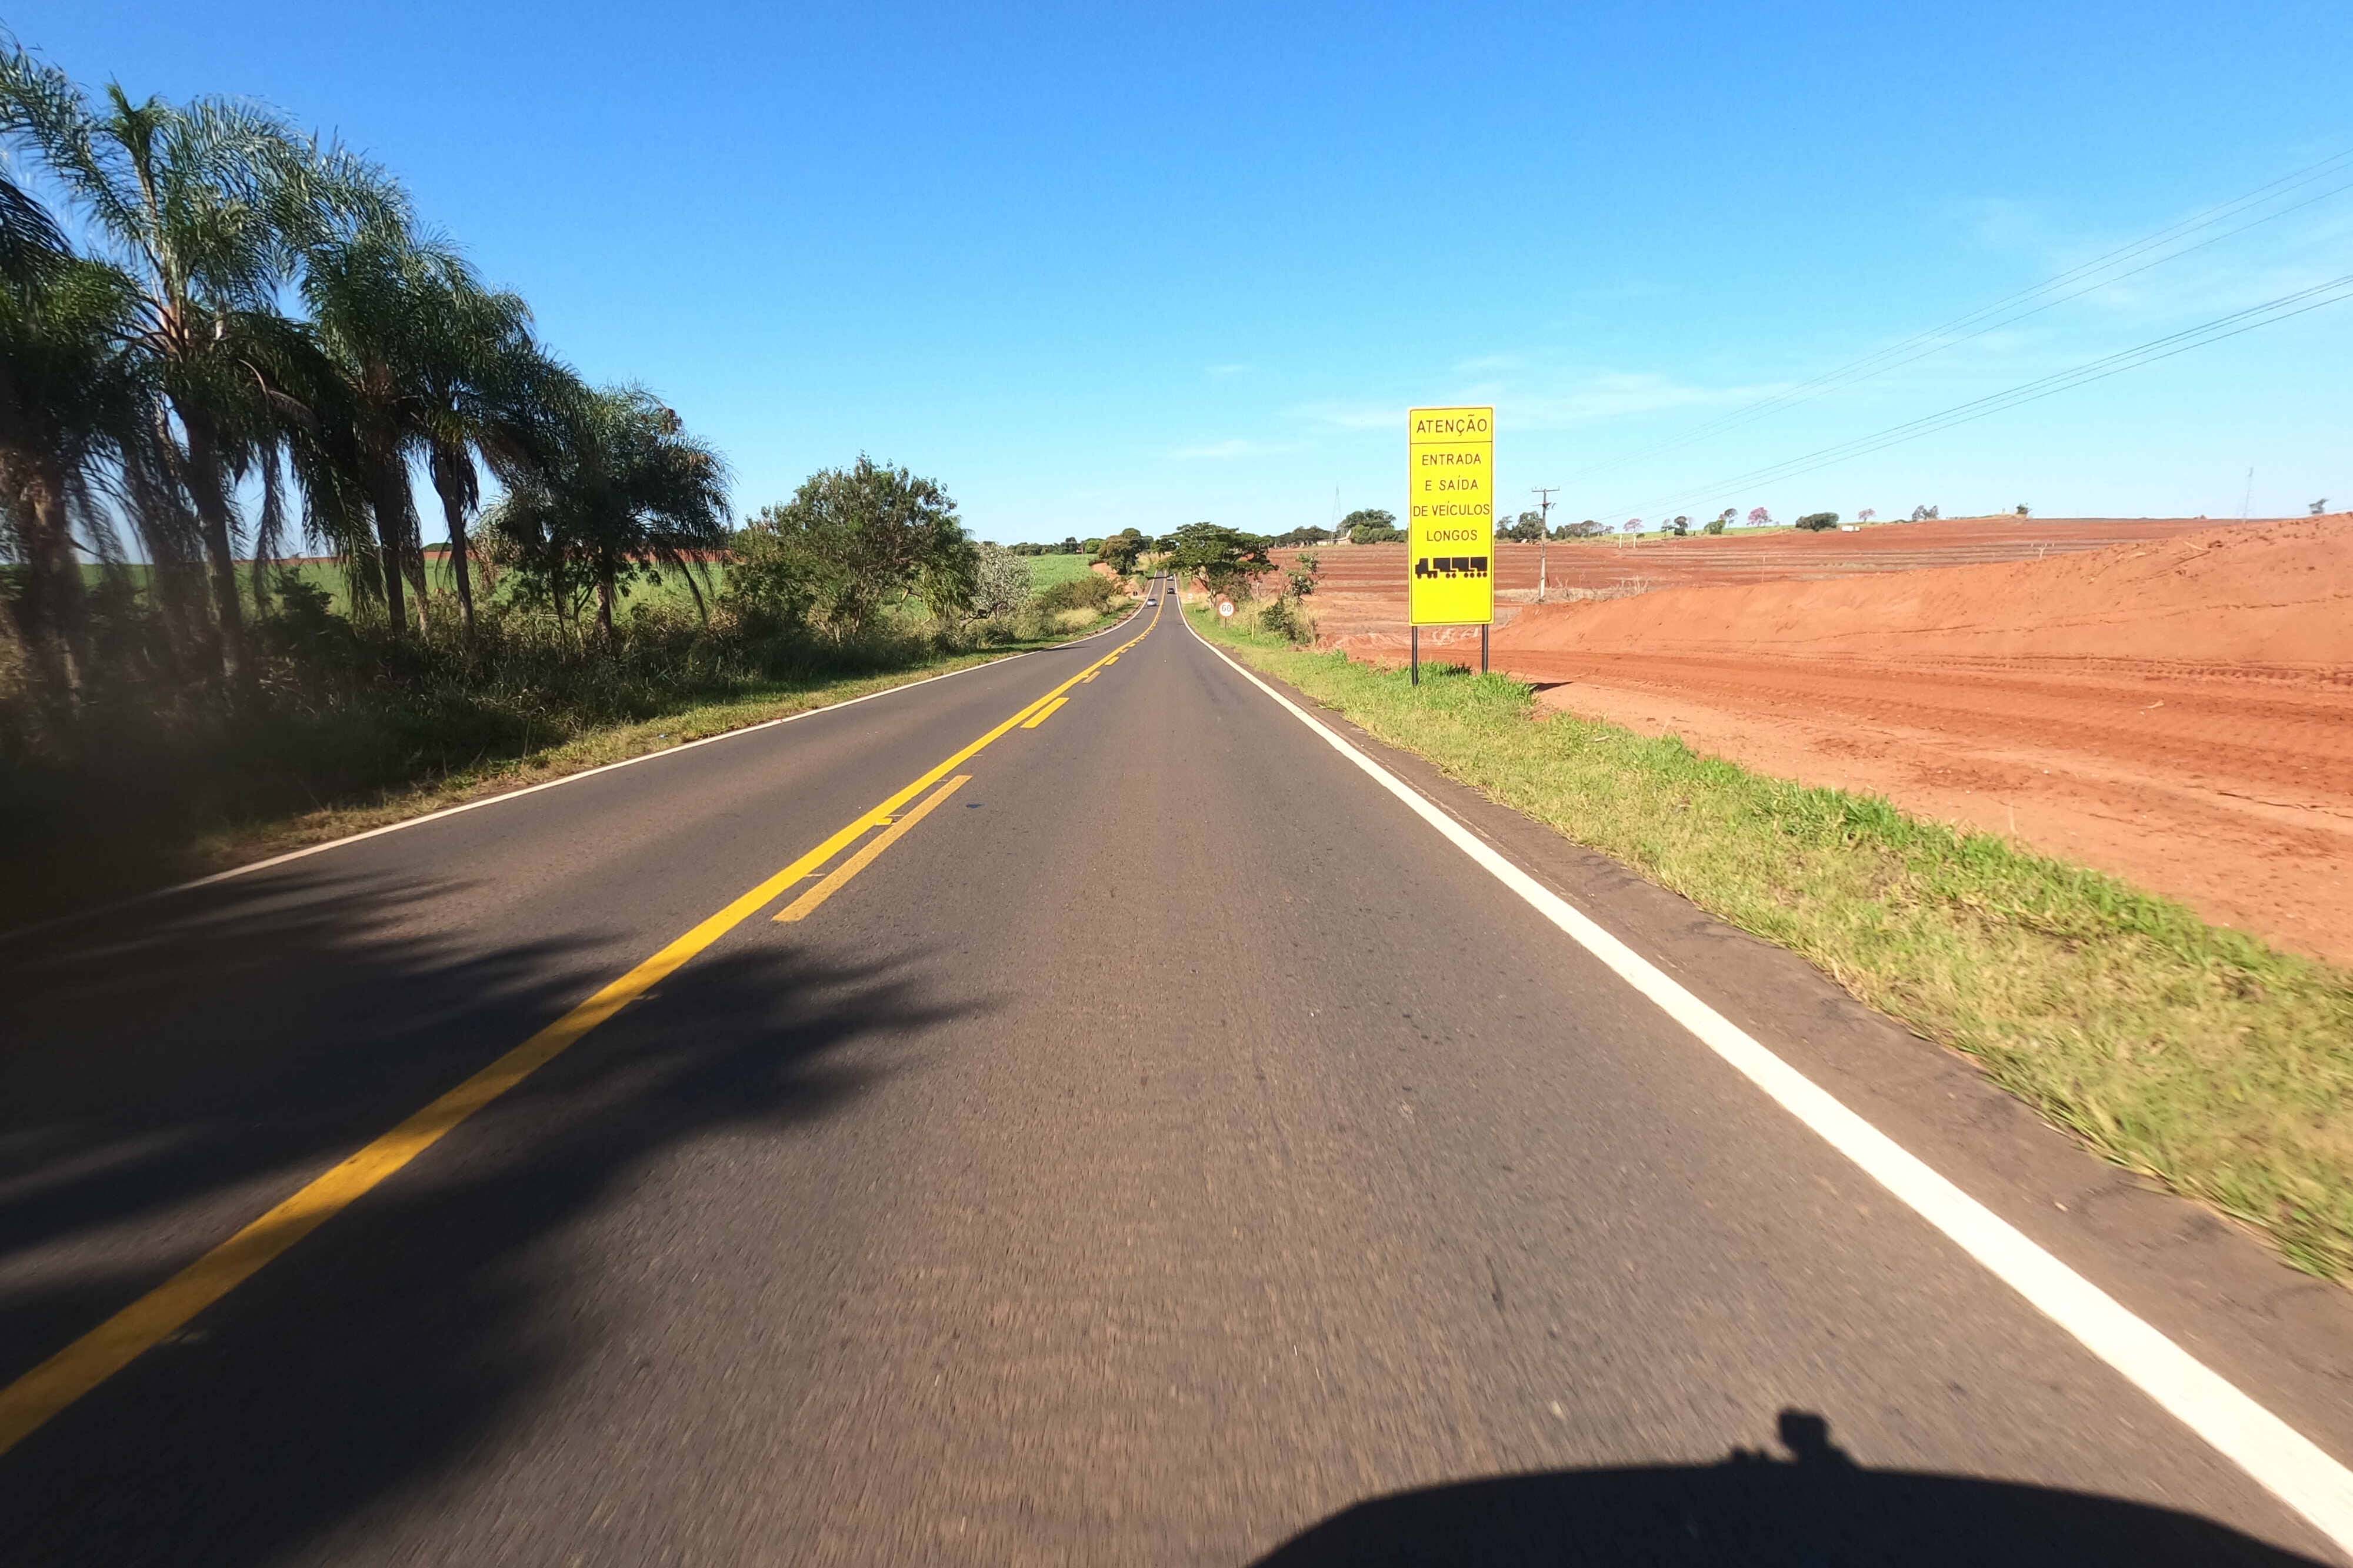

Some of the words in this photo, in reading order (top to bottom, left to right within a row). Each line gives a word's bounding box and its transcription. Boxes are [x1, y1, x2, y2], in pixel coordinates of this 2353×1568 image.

[1417, 414, 1487, 436] ATENÇÃO
[1422, 453, 1481, 466] ENTRADA
[1425, 480, 1432, 491] E
[1439, 475, 1479, 491] SAÍDA
[1413, 506, 1428, 516] DE
[1432, 501, 1490, 516] VEÍCULOS
[1427, 529, 1478, 542] LONGOS
